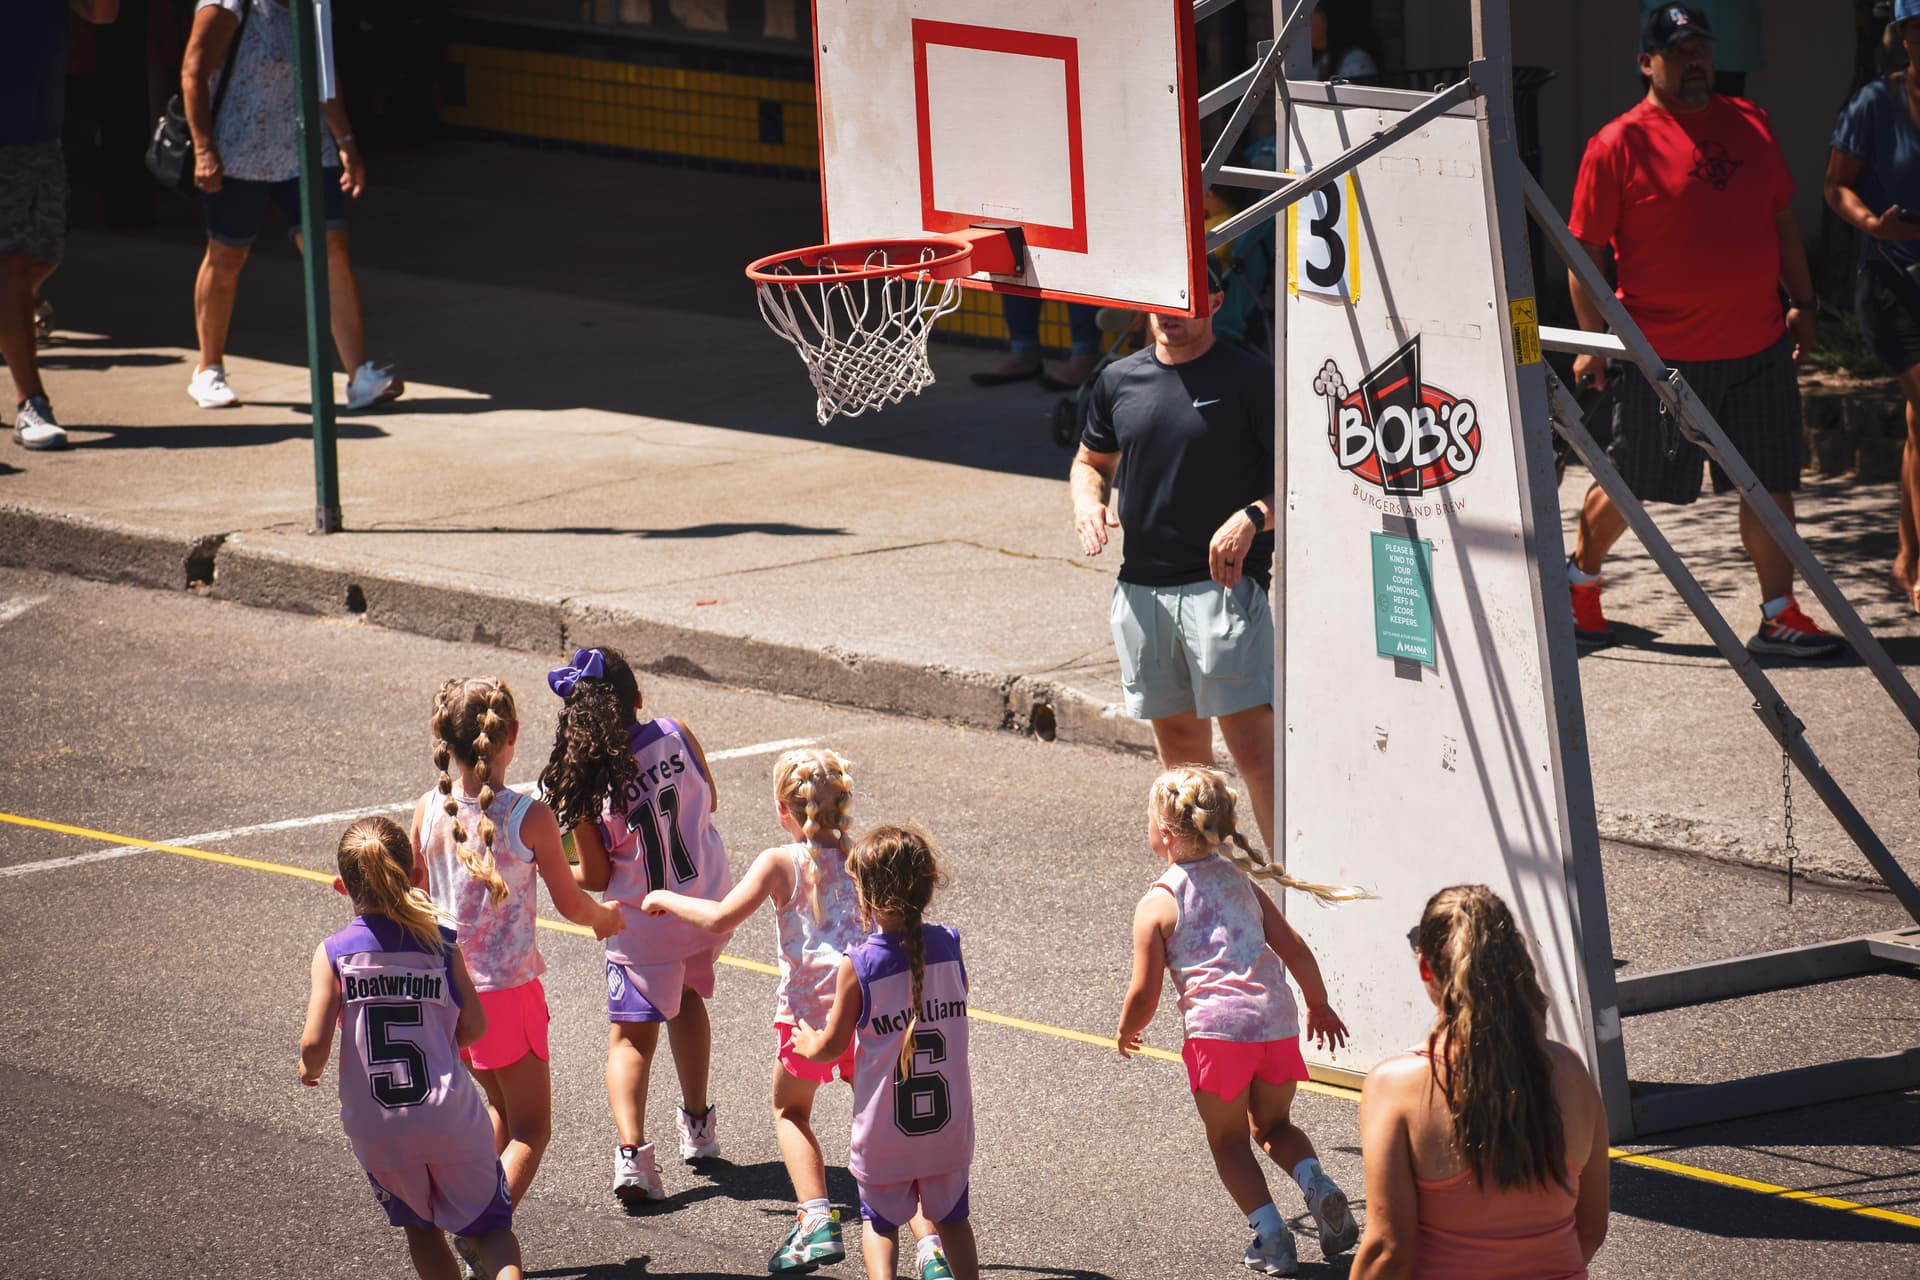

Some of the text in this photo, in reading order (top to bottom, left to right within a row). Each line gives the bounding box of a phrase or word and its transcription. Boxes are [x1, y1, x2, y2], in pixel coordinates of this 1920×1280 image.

[1306, 179, 1346, 288] 3
[1337, 400, 1476, 473] BOB'S
[1352, 483, 1465, 517] BURGERS AND BREW
[1385, 543, 1408, 555] PLEASE
[1389, 554, 1415, 566] KIND TO
[1392, 575, 1413, 586] COURT
[1393, 564, 1411, 576] YOUR
[1393, 595, 1409, 606] REFS
[1393, 605, 1415, 617] SCORE
[1404, 643, 1428, 655] MANNA
[624, 754, 685, 802] orres
[625, 783, 699, 894] 11
[345, 972, 443, 1001] Boatwright
[364, 1002, 432, 1110] 5
[893, 1028, 952, 1137] 6
